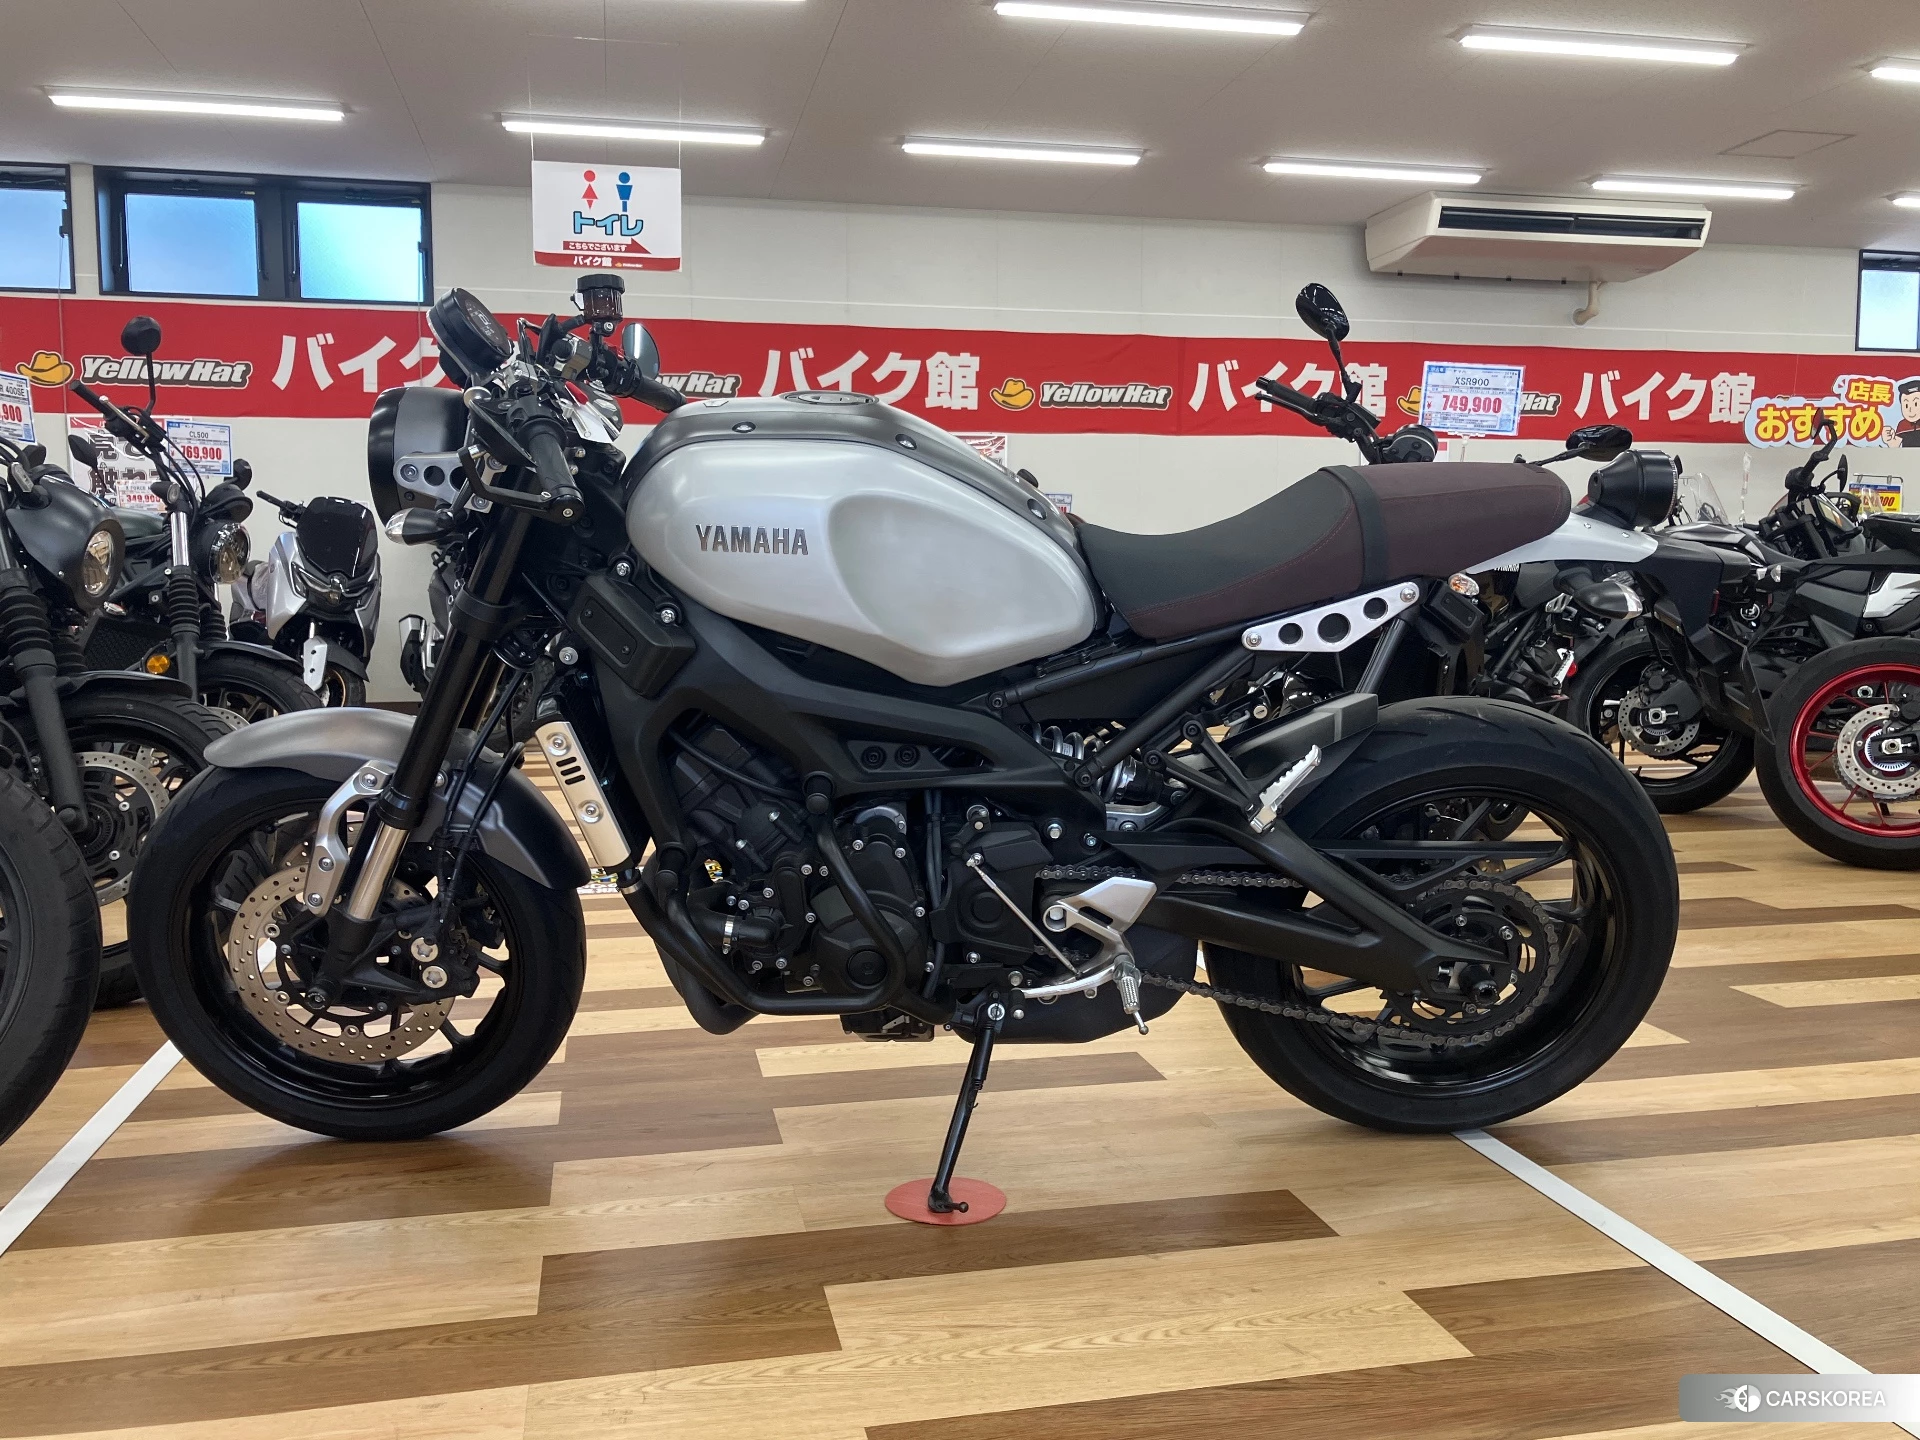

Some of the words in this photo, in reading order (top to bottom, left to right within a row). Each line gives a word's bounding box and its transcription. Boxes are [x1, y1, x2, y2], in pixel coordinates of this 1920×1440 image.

[573, 211, 644, 236] トイレ
[568, 242, 627, 252] こちらでございます
[573, 255, 613, 268] バイク館
[83, 356, 248, 384] YellowHat
[271, 333, 441, 393] バイク
[758, 347, 981, 410] バイク館
[1454, 376, 1490, 387] XSR900
[6, 385, 25, 397] 400SE
[1042, 384, 1169, 405] YellowHat
[1574, 370, 1756, 424] バイク館
[1848, 381, 1893, 403] 店長
[1442, 394, 1503, 414] 749,900
[1757, 405, 1882, 440] おすすめ
[189, 431, 209, 439] CL500
[181, 445, 223, 460] 769,900
[696, 524, 809, 556] YAMAHA
